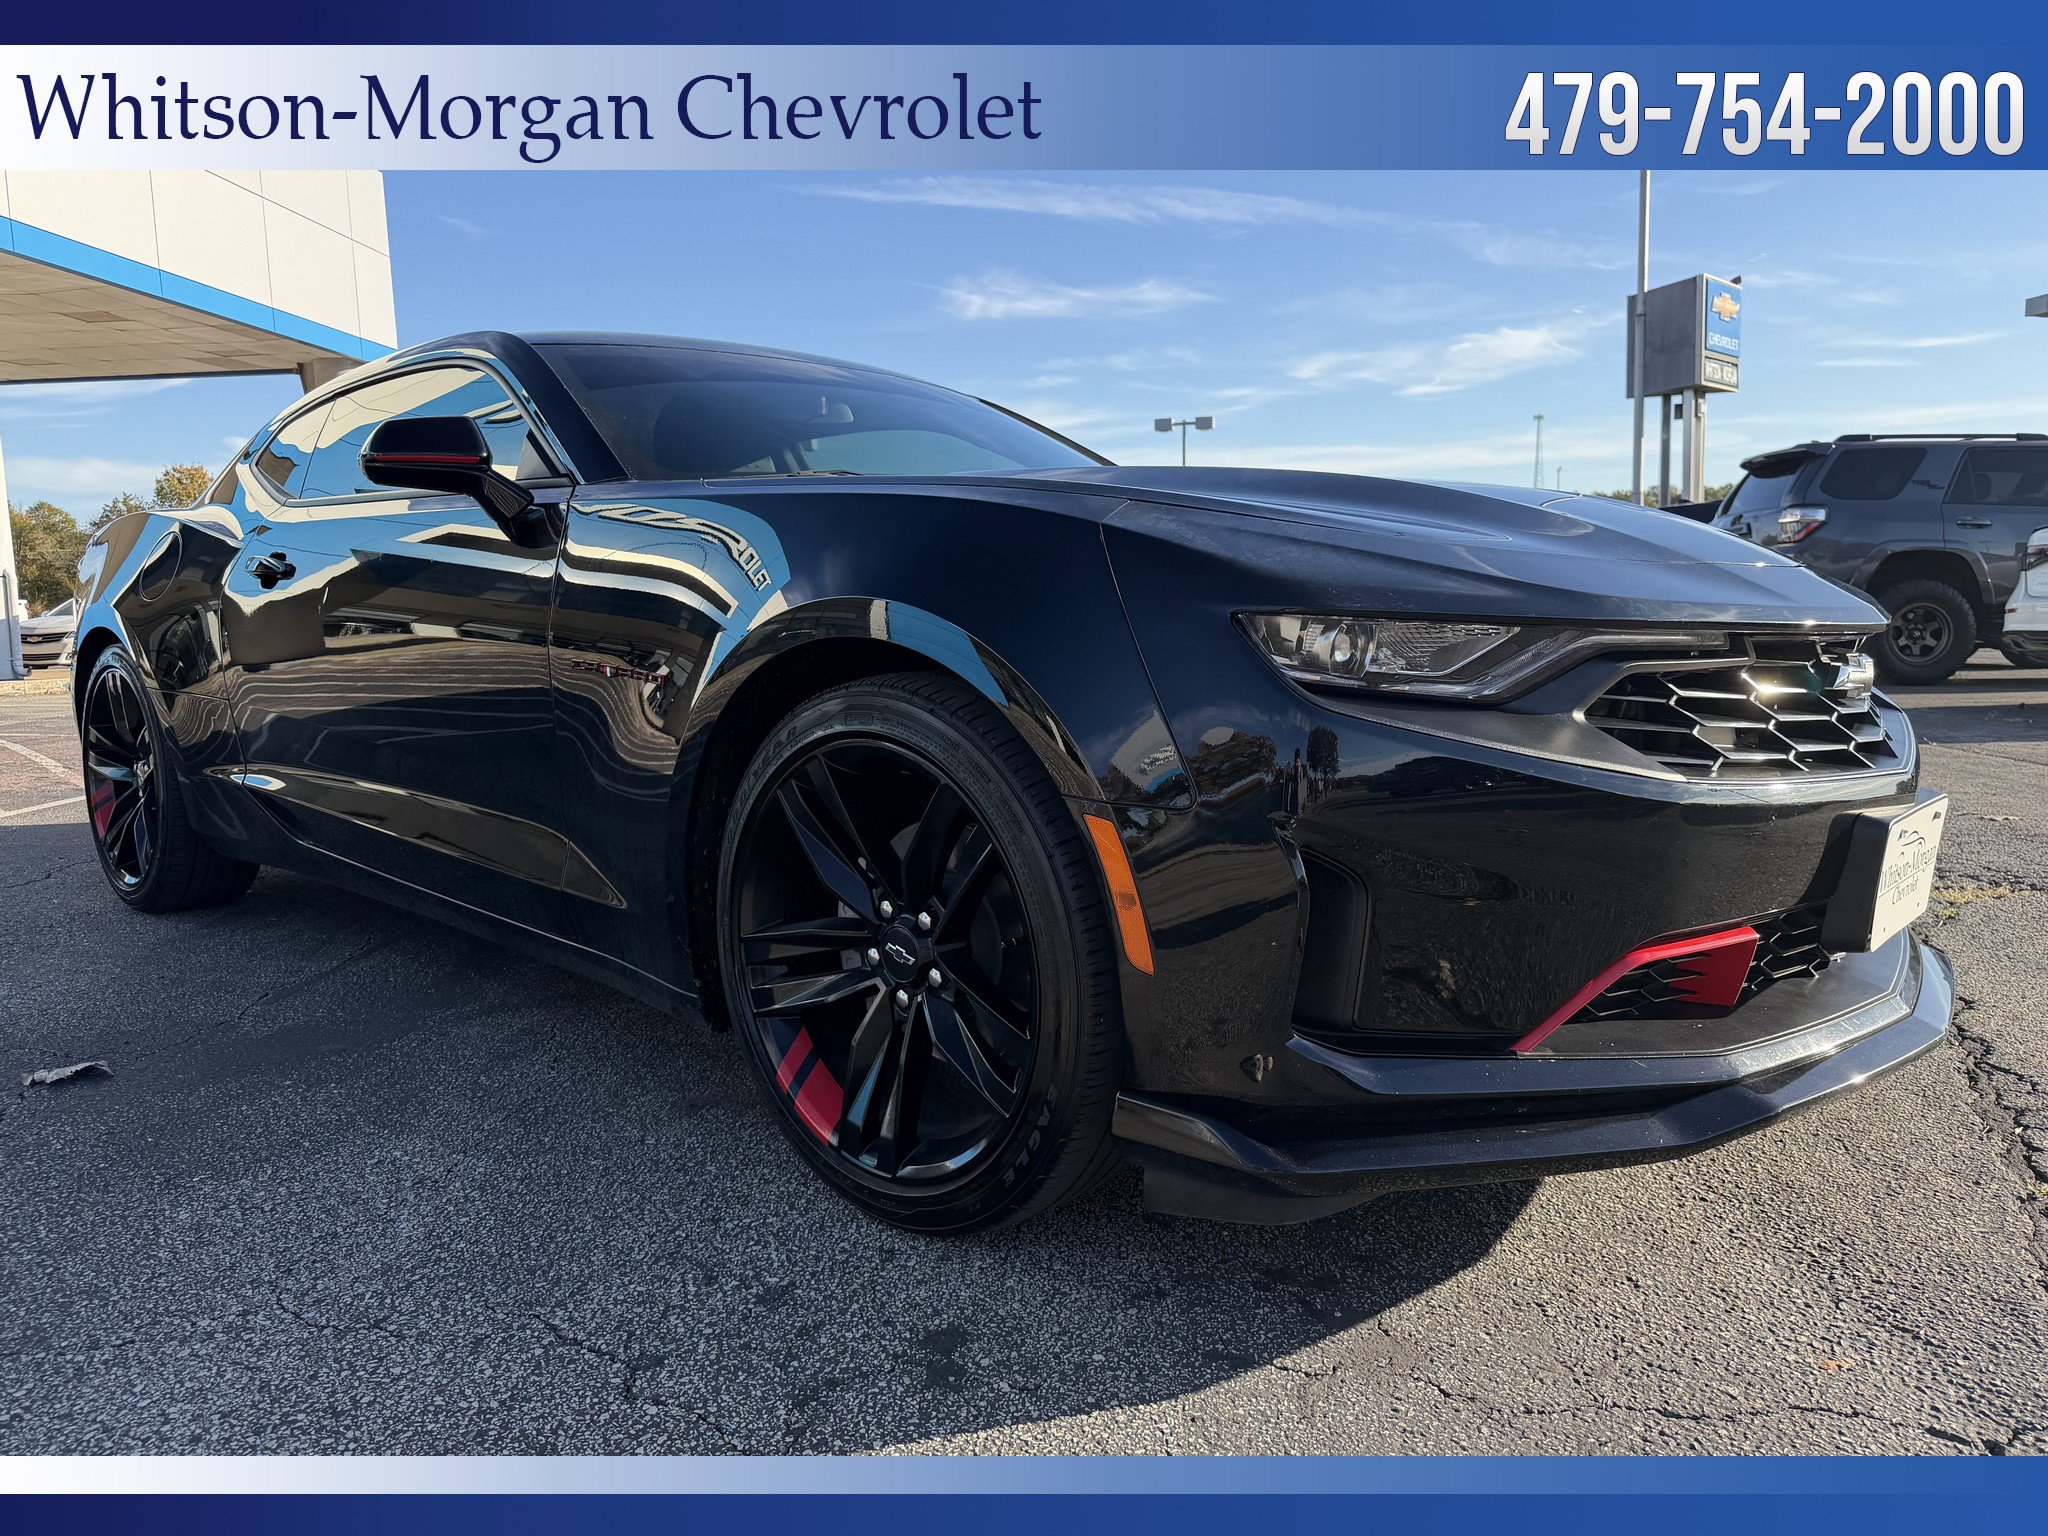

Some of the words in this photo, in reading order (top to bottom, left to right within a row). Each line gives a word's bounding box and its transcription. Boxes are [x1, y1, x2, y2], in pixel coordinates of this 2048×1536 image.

[1709, 333, 1739, 350] CHEVROLET
[1879, 844, 1937, 893] Whitson-Morgan
[1892, 877, 1918, 905] Chevrolet
[1003, 1082, 1058, 1188] EAGLE
